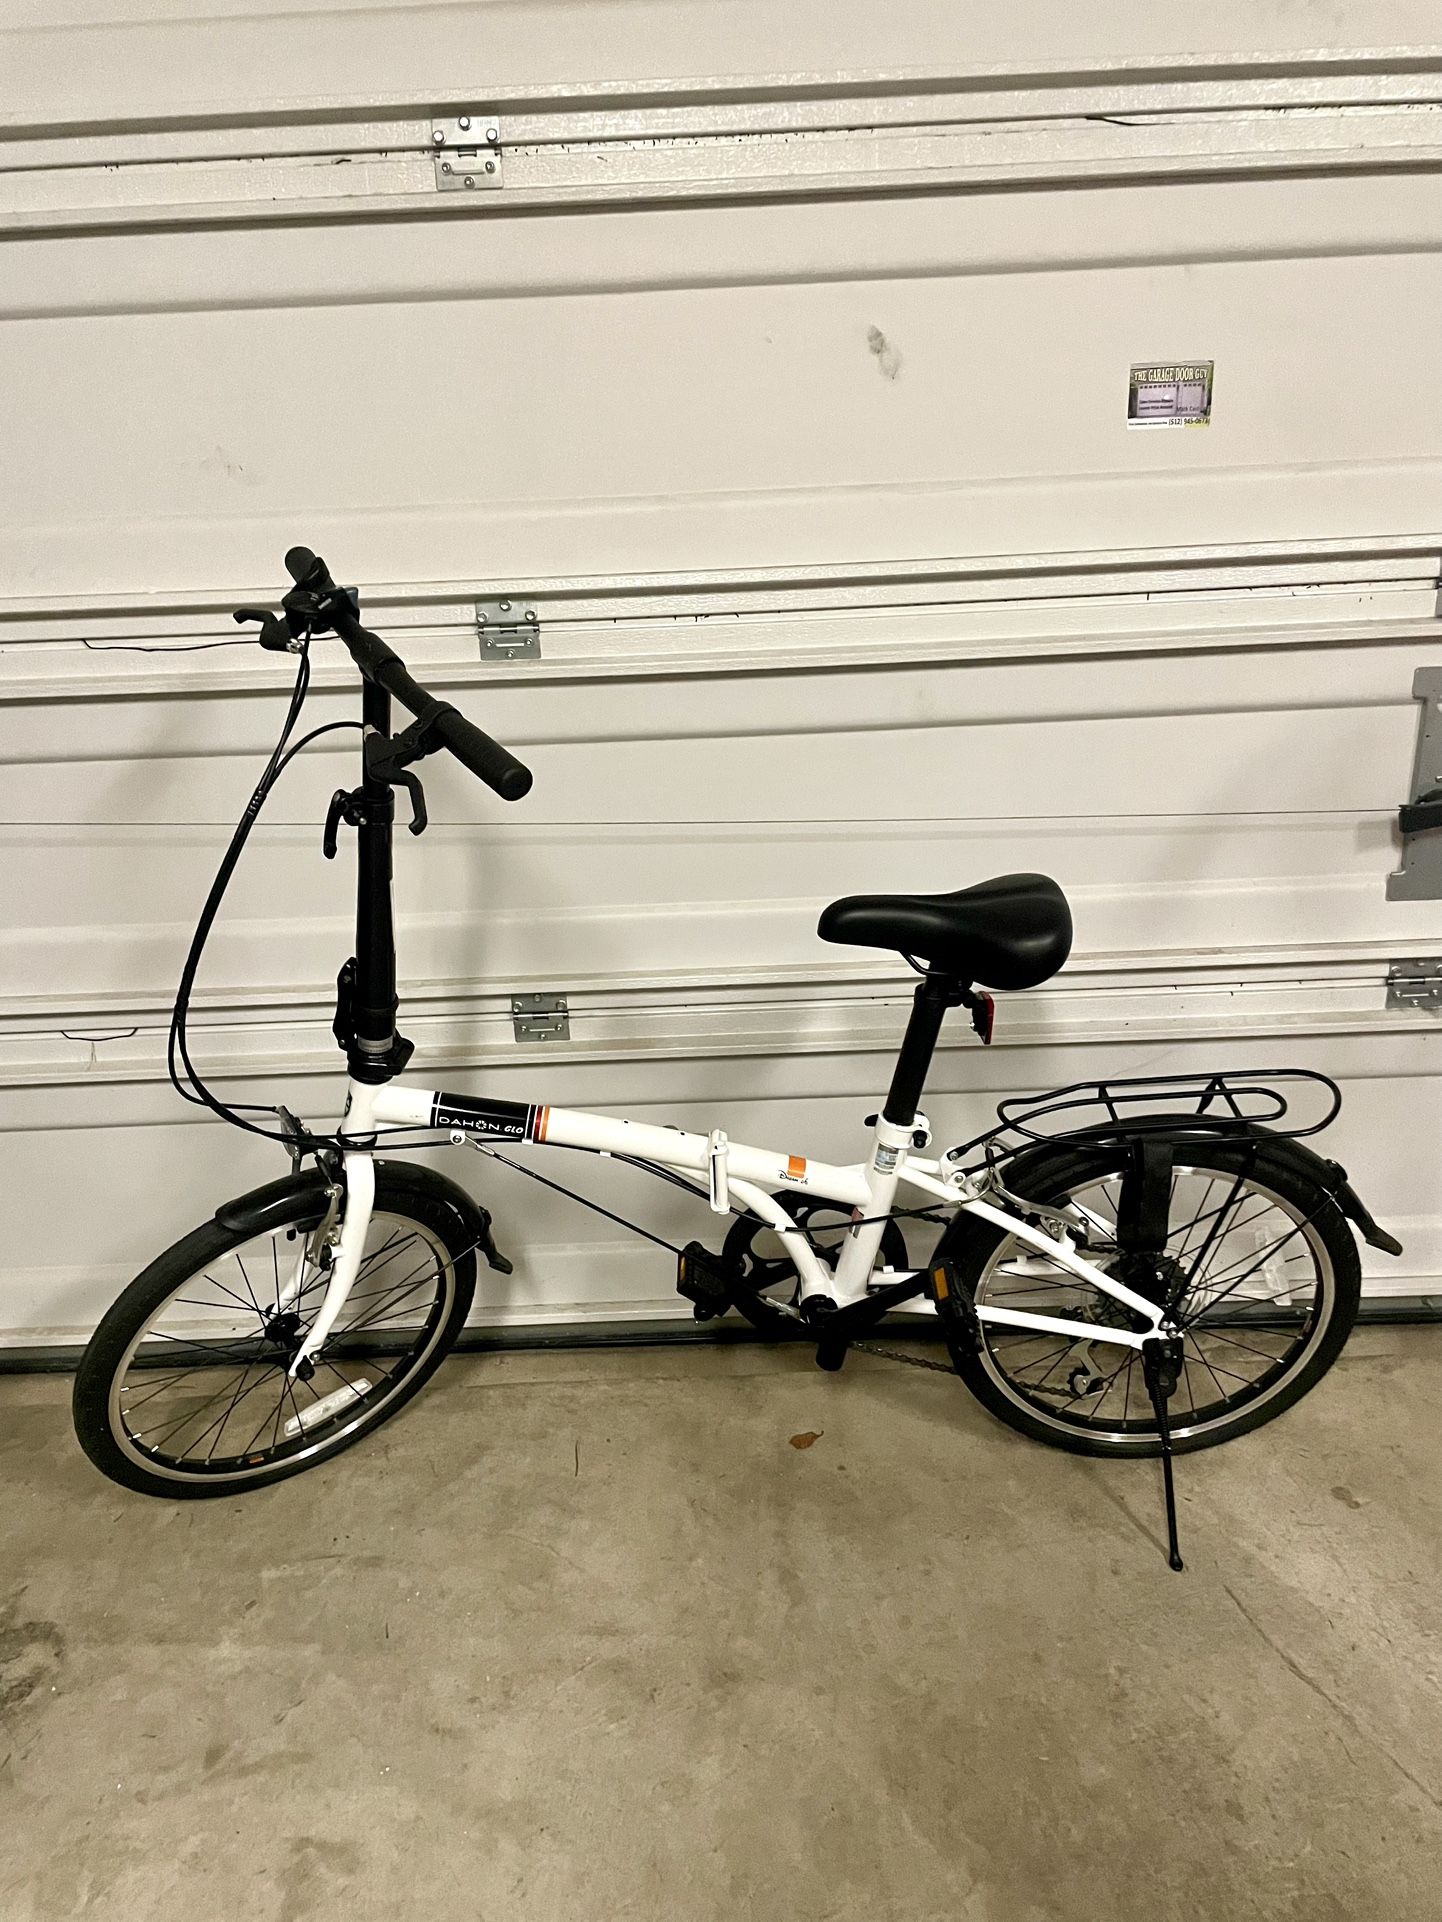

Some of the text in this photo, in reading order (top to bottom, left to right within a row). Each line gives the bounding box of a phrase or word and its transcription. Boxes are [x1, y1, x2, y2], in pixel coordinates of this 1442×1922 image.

[1134, 367, 1208, 382] THE GARAGE DOOR GUY
[1168, 418, 1183, 426] (512)
[439, 1116, 524, 1134] DAHON GLO
